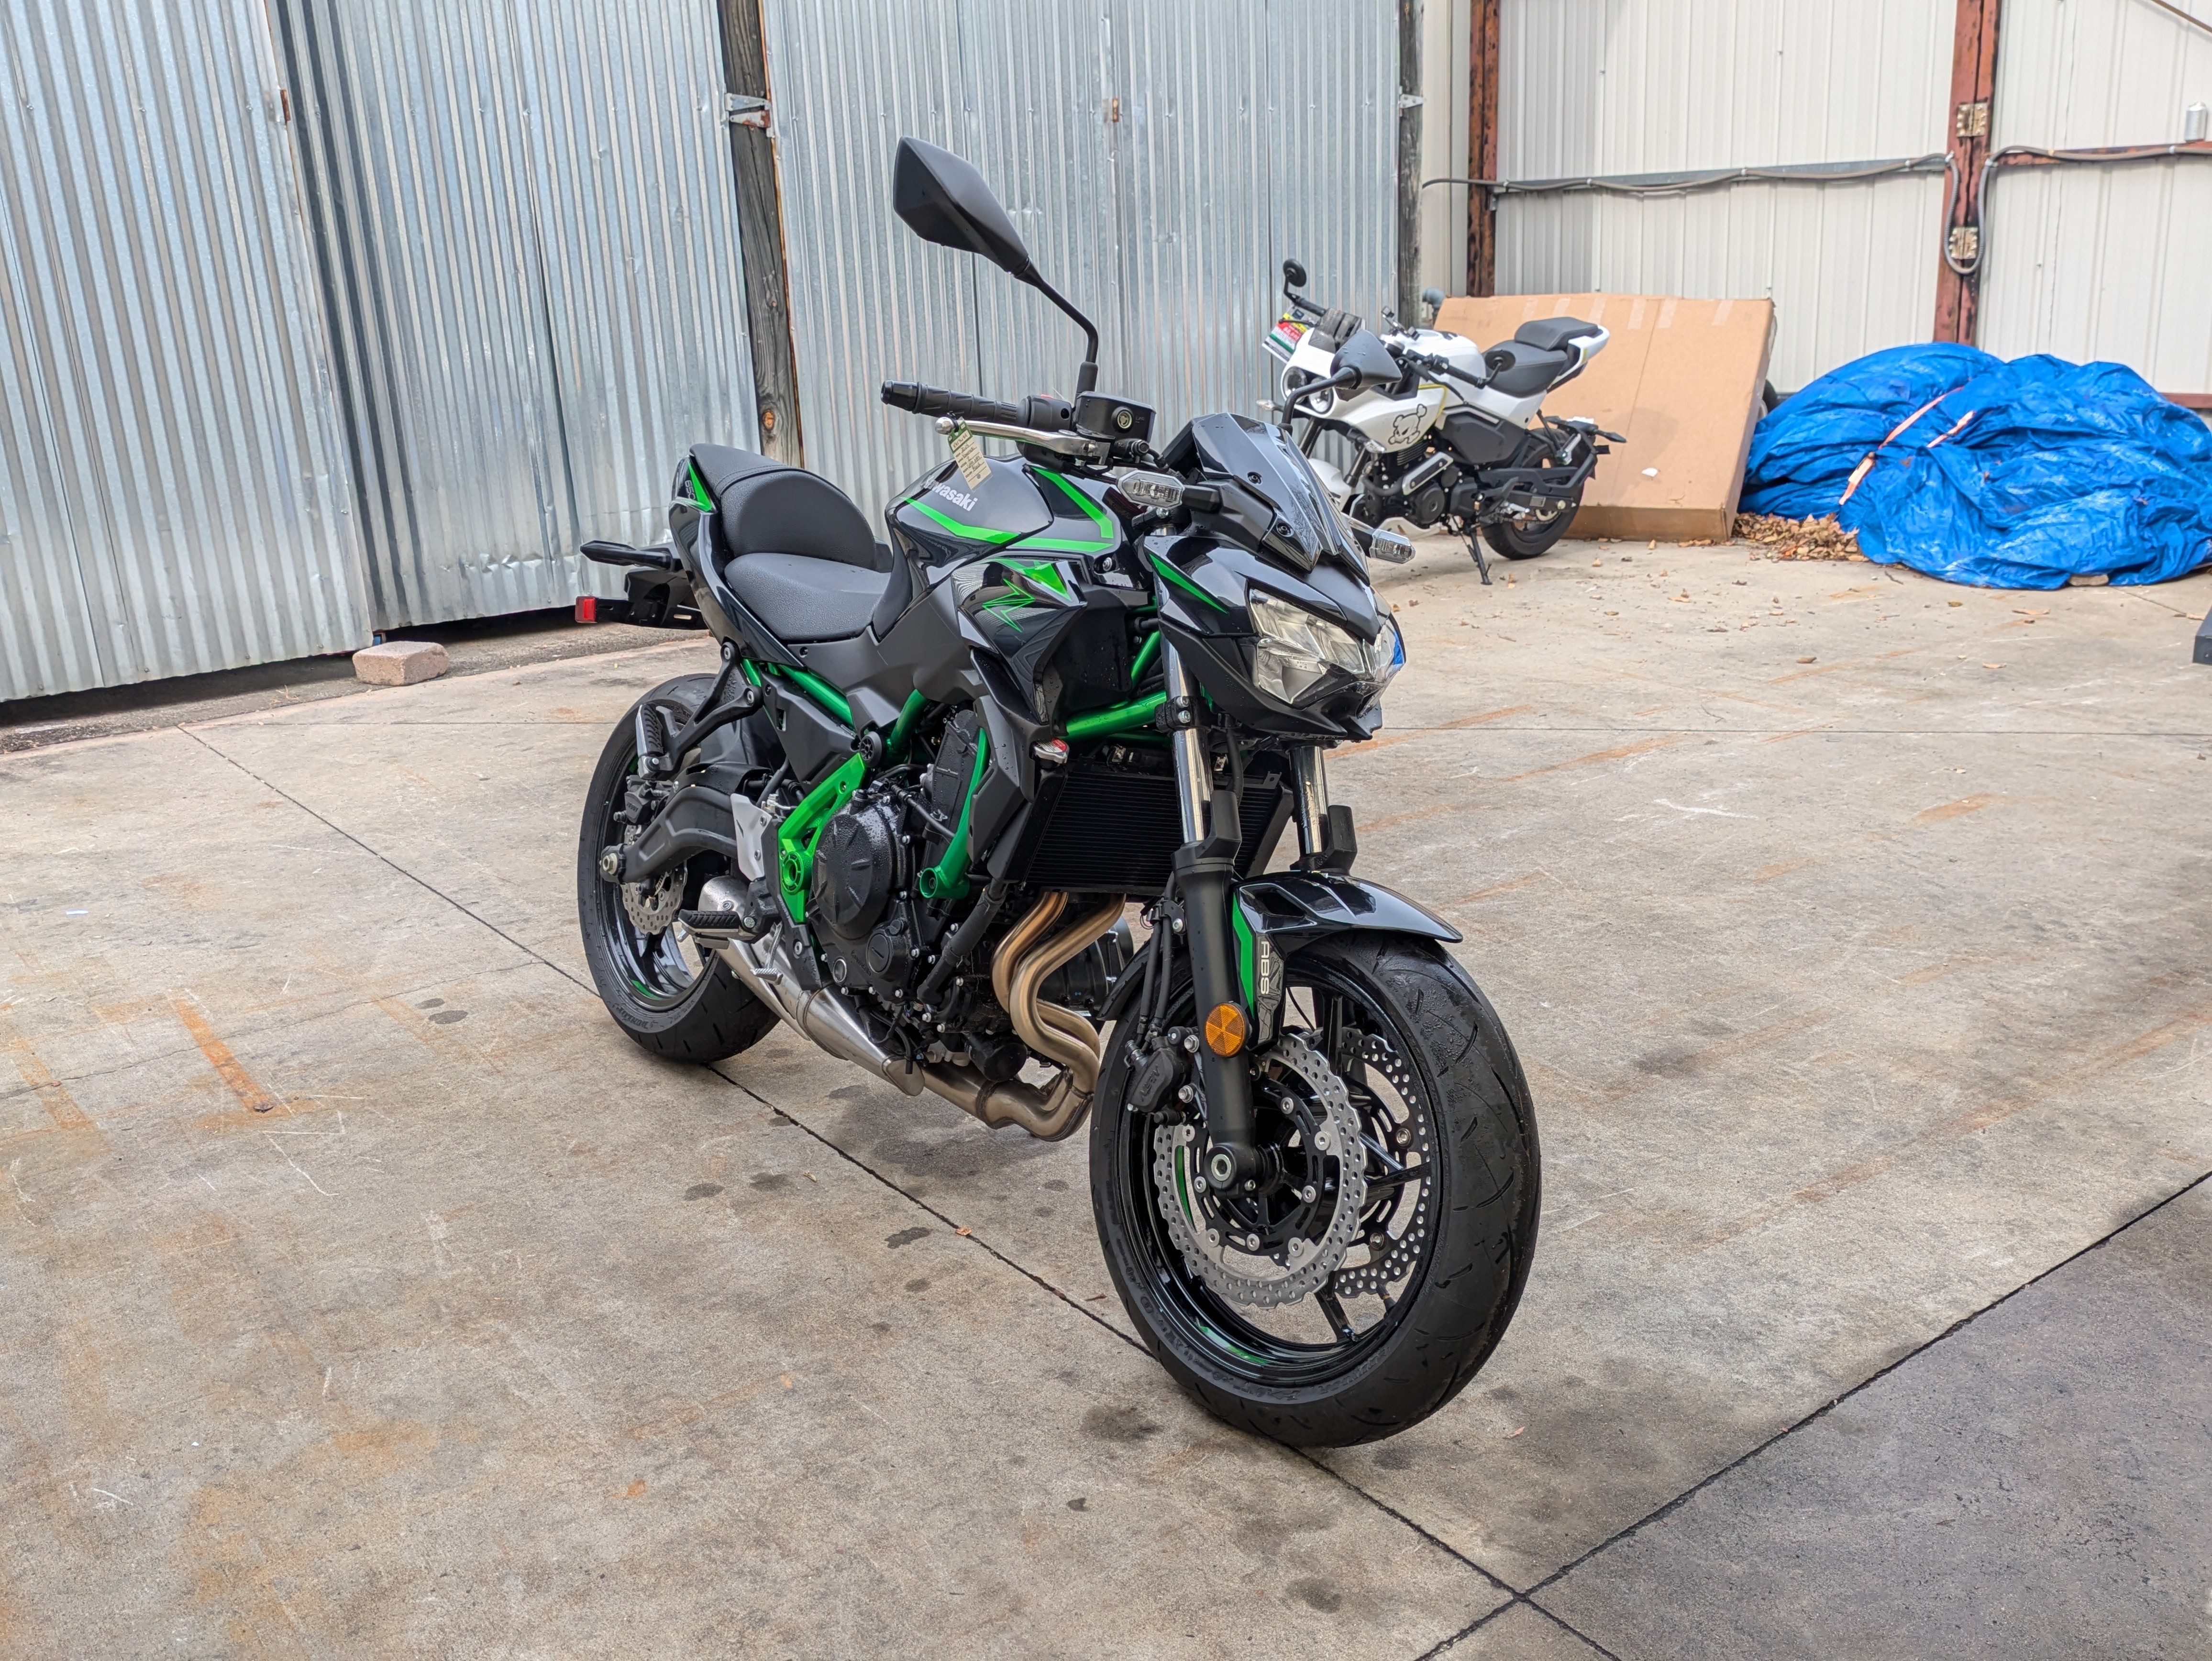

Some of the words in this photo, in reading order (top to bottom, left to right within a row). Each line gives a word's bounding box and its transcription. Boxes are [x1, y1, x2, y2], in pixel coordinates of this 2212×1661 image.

[685, 480, 696, 500] 650
[920, 475, 978, 511] Kawasaki
[1261, 941, 1270, 995] ABS
